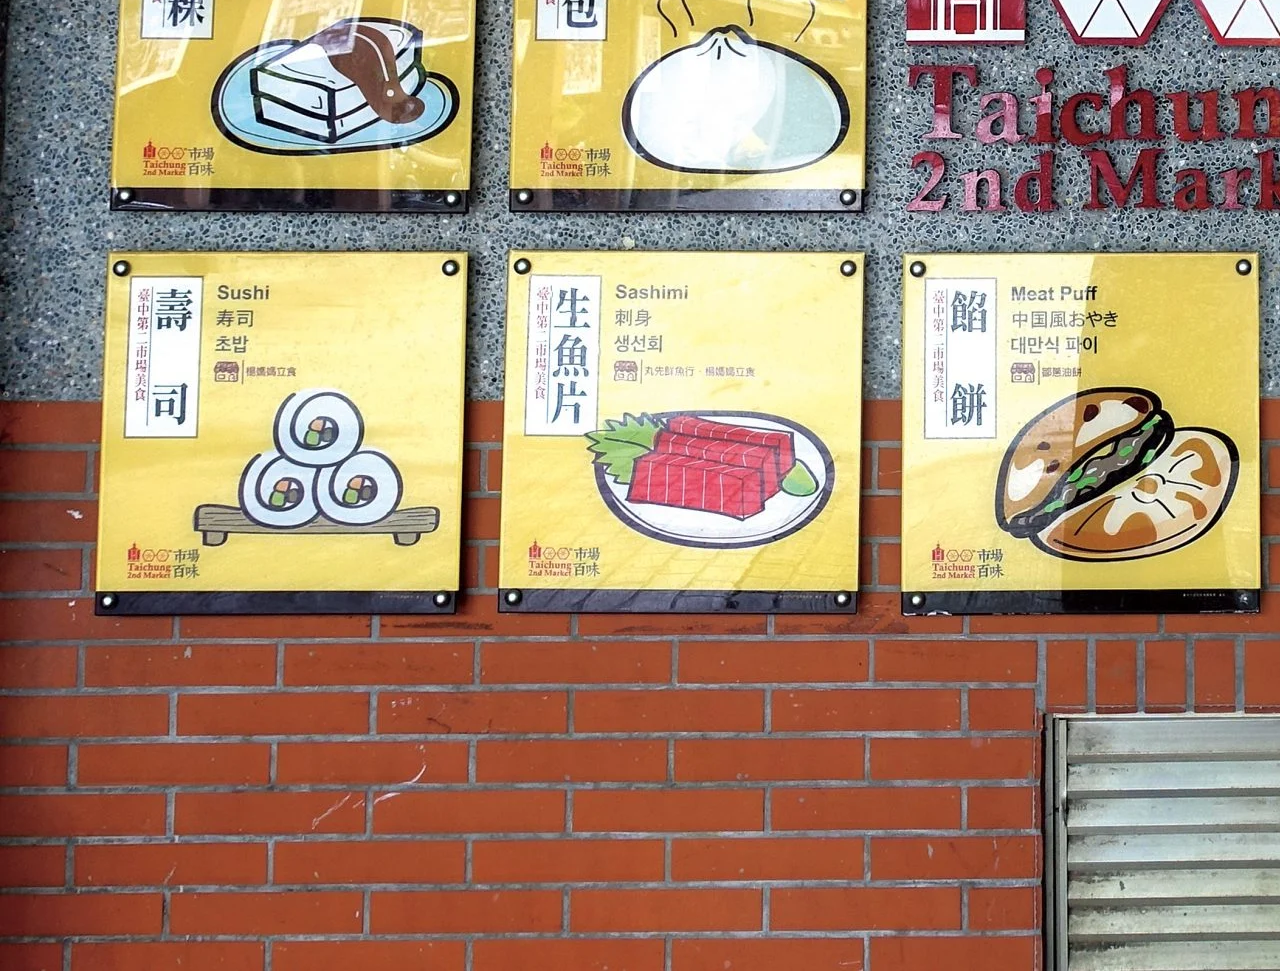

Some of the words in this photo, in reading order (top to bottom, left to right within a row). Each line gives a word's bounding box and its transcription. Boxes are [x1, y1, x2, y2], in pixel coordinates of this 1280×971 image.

[189, 147, 214, 161] 市場
[143, 161, 186, 169] Taichung
[188, 162, 215, 176] 百味
[906, 149, 1061, 214] 2nd
[218, 285, 269, 300] Sushi
[615, 285, 689, 300] Sashimi
[1011, 286, 1054, 301] Meat
[1061, 286, 1098, 301] Puff
[216, 310, 254, 327] 寿司
[615, 309, 652, 327] 刺身
[1012, 310, 1118, 328] 中国風おやき
[215, 336, 248, 353] 초밥
[614, 335, 663, 353] 생선회
[1011, 336, 1059, 353] 대만식
[1066, 336, 1098, 354] 파이
[152, 288, 193, 426] 壽司
[552, 287, 591, 424] 生魚片
[950, 290, 987, 426] 餡餅
